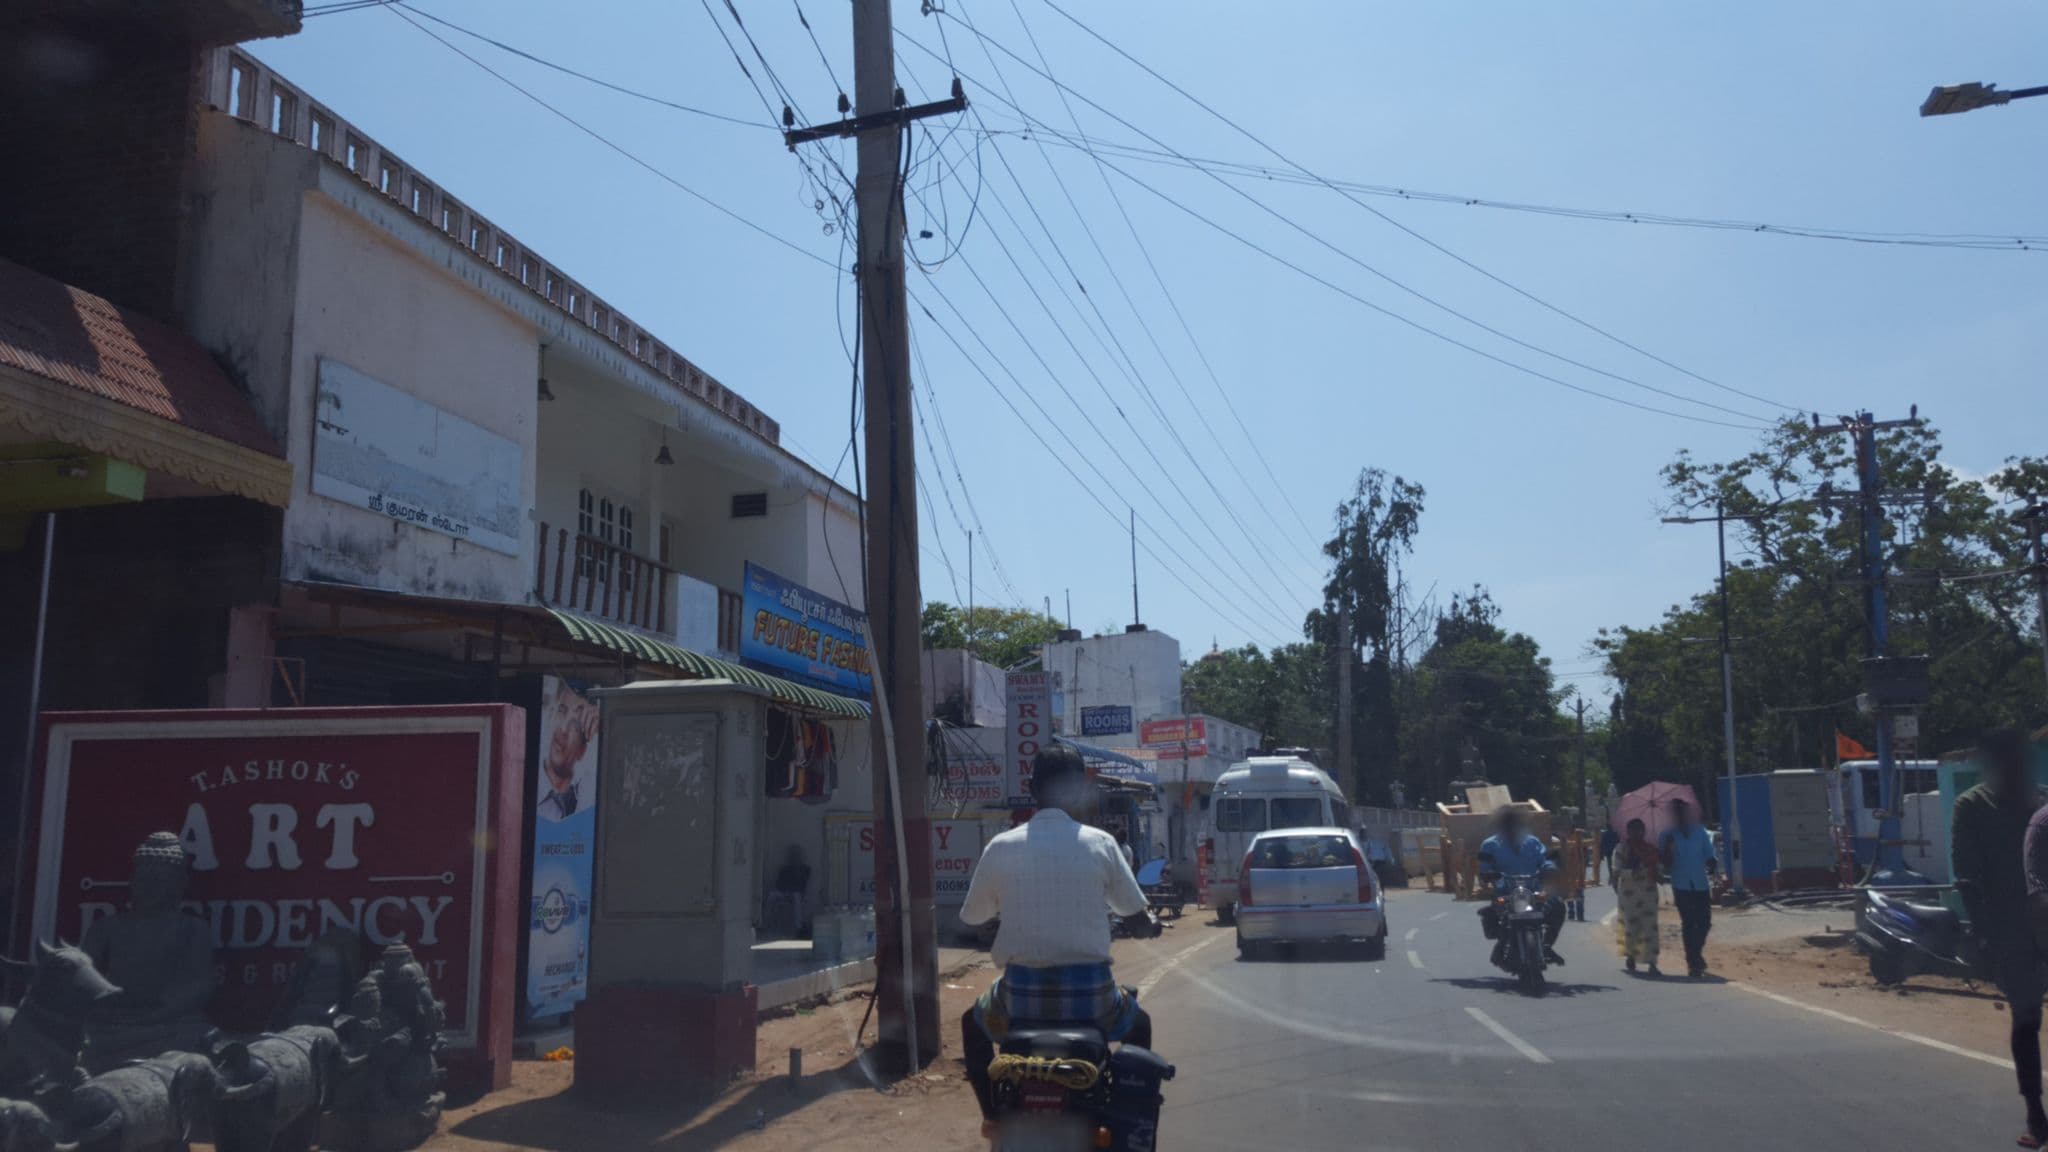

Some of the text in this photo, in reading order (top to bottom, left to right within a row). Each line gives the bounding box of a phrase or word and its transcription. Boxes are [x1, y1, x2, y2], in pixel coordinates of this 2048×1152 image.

[753, 608, 820, 661] FUTURE
[1084, 713, 1130, 729] ROOMS
[178, 802, 376, 871] ART
